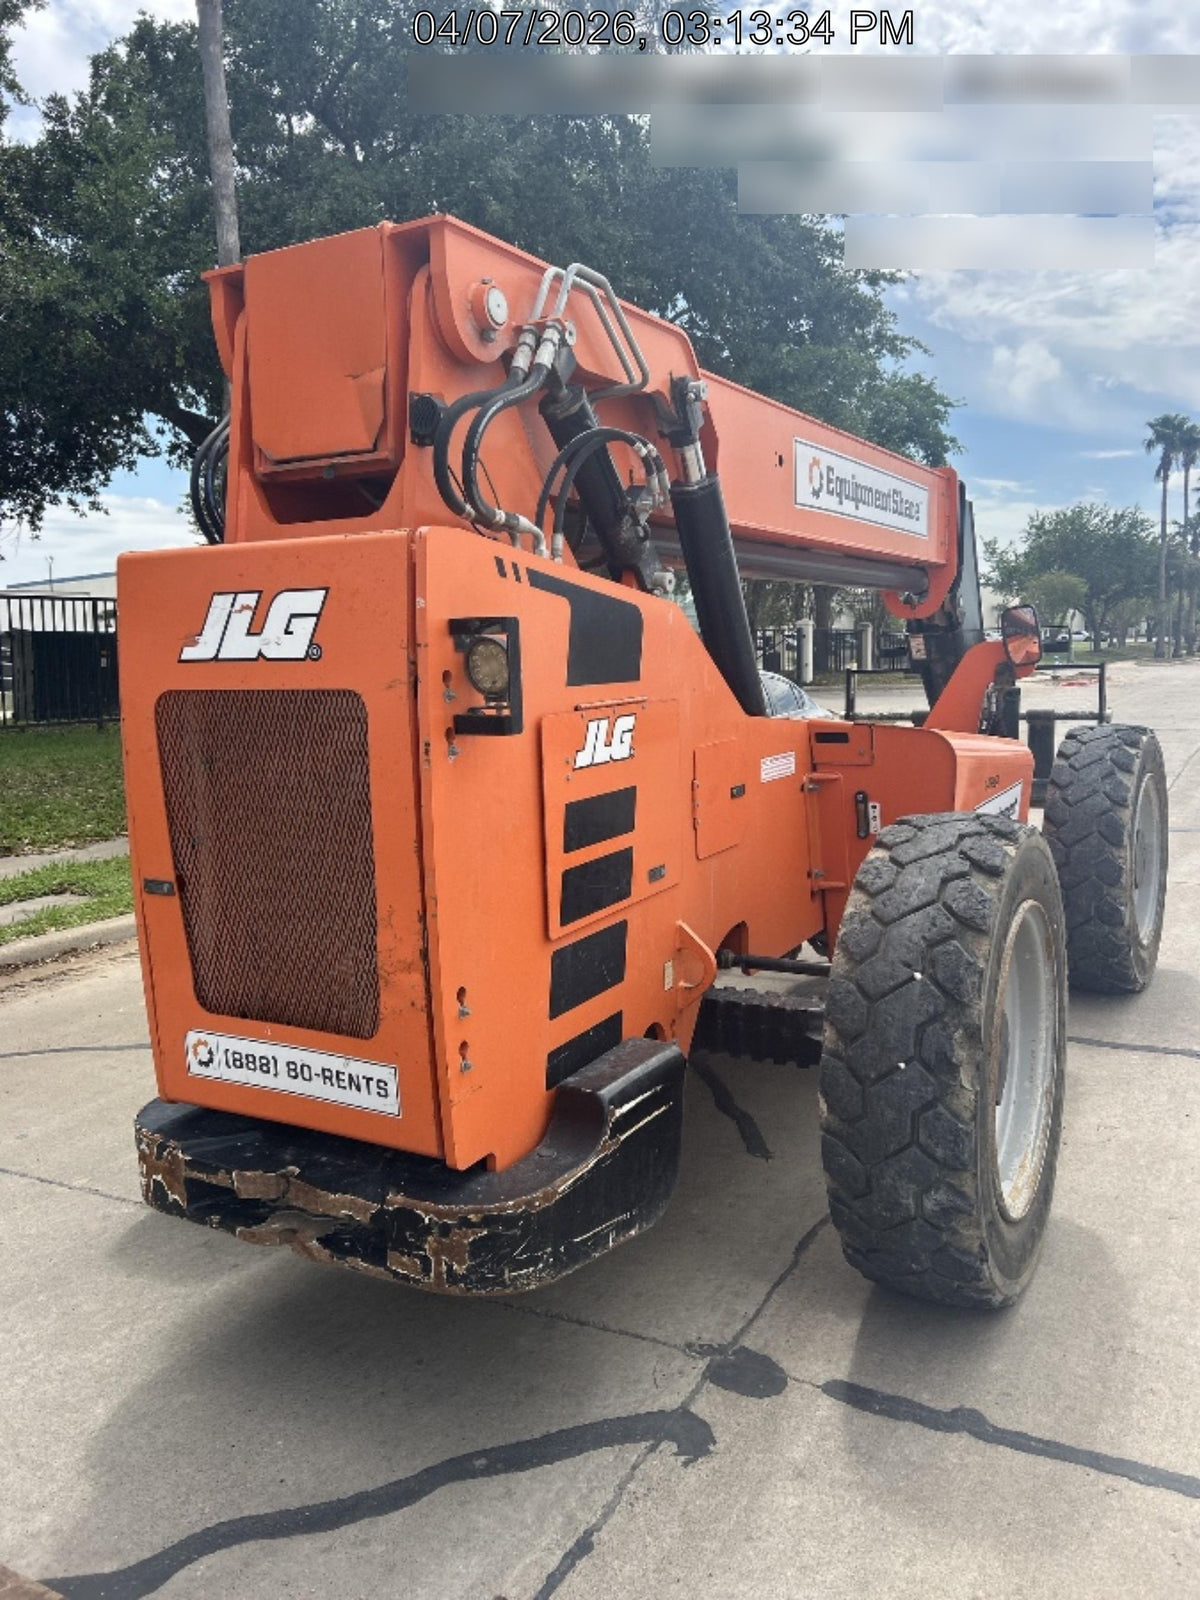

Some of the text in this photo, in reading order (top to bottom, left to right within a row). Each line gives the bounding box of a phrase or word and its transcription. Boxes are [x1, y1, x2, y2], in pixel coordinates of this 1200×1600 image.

[178, 586, 331, 663] JLG
[572, 712, 637, 772] JLG
[224, 1048, 389, 1099] (888) 80-RENTS
